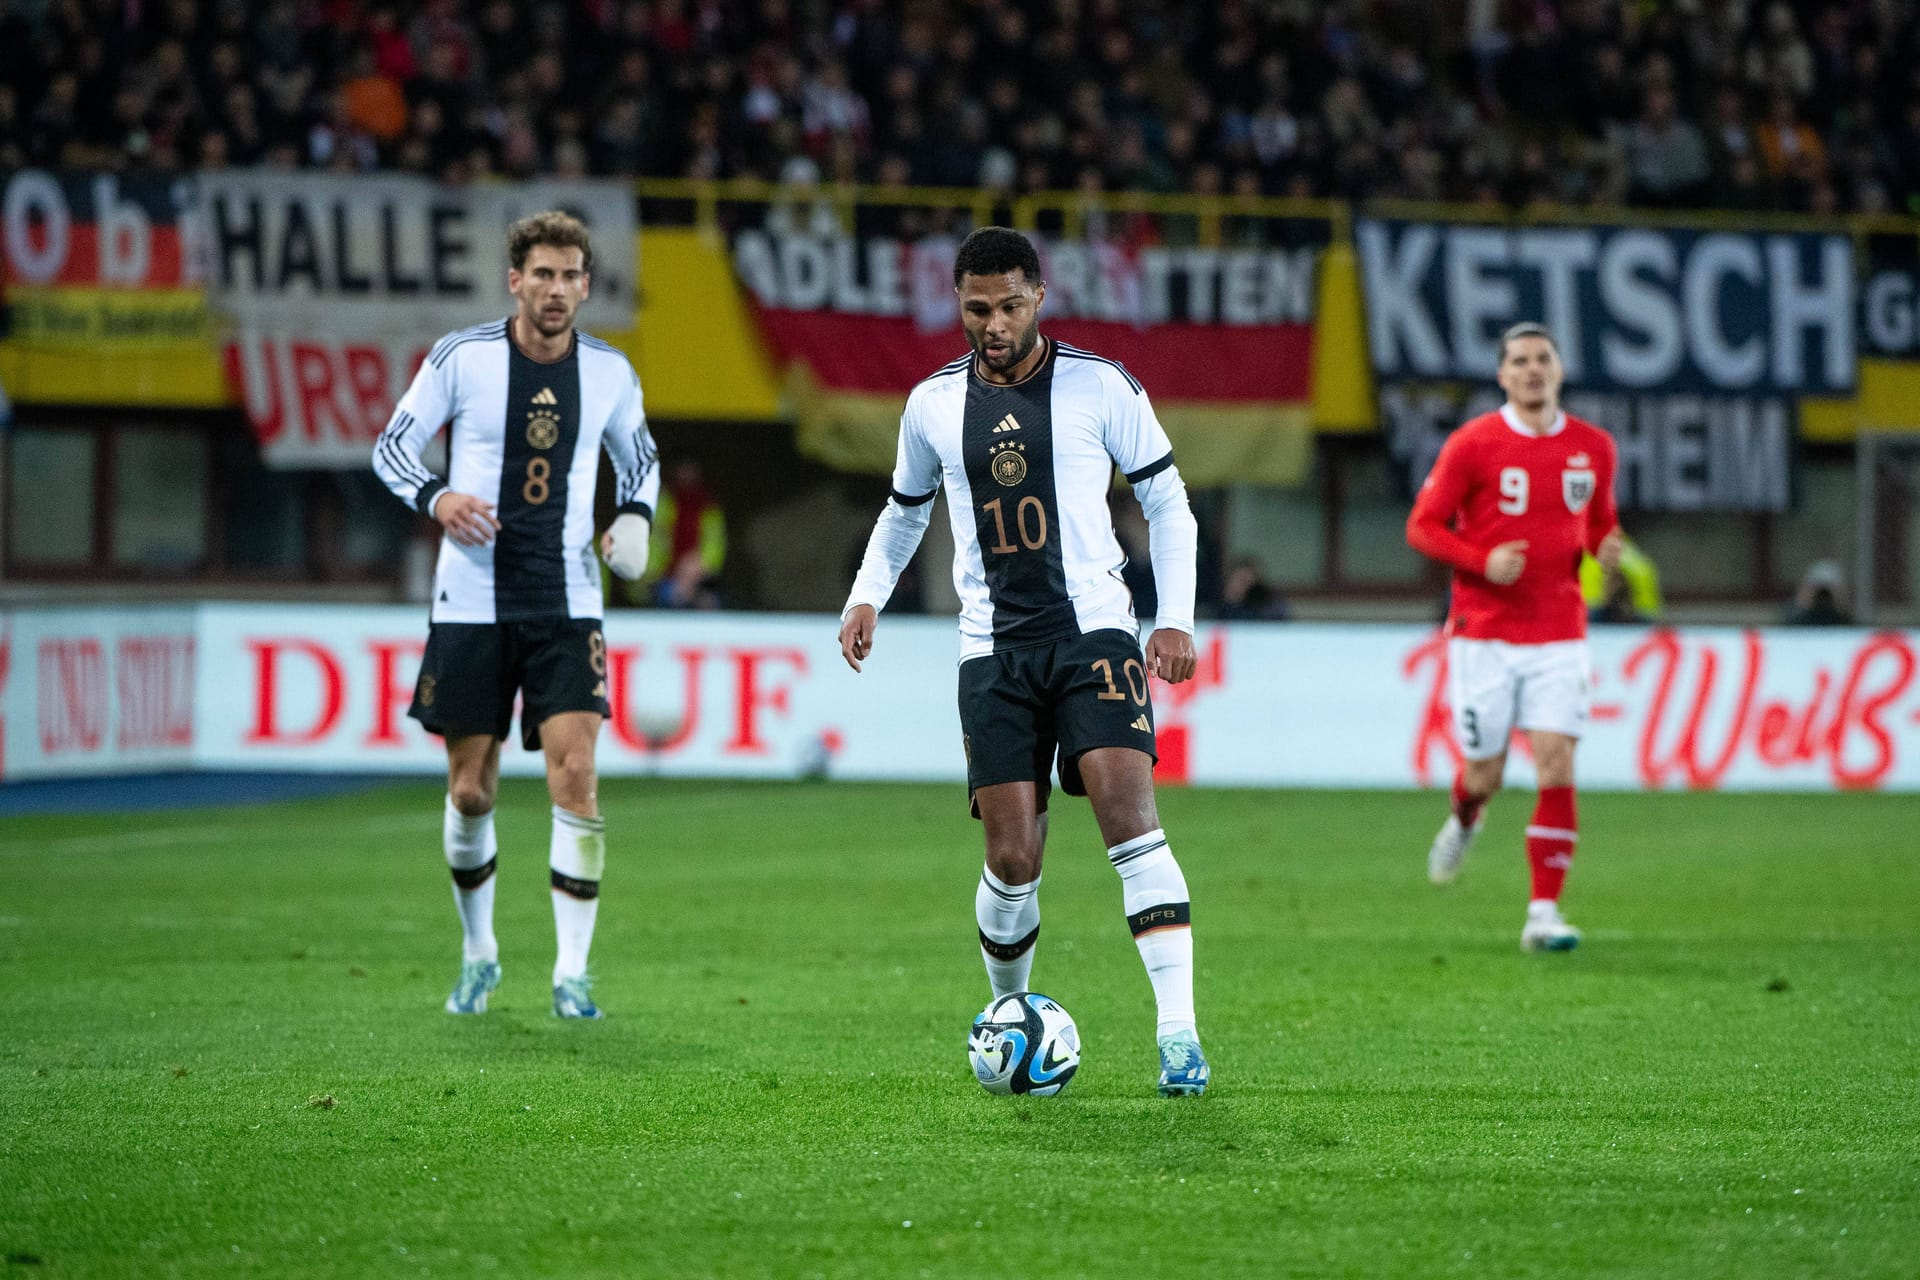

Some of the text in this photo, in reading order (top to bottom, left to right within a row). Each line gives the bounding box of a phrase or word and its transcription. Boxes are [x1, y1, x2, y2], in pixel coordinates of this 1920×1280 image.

[212, 191, 473, 297] HALLE
[1356, 219, 1857, 391] KETSCH
[1866, 270, 1920, 350] G
[222, 340, 447, 446] URB
[523, 456, 551, 505] 8
[1499, 466, 1530, 516] 9
[982, 495, 1047, 554] 10
[588, 629, 607, 677] 8
[1091, 657, 1148, 707] 10
[241, 636, 847, 757] DRUF.
[1139, 909, 1176, 926] DFB
